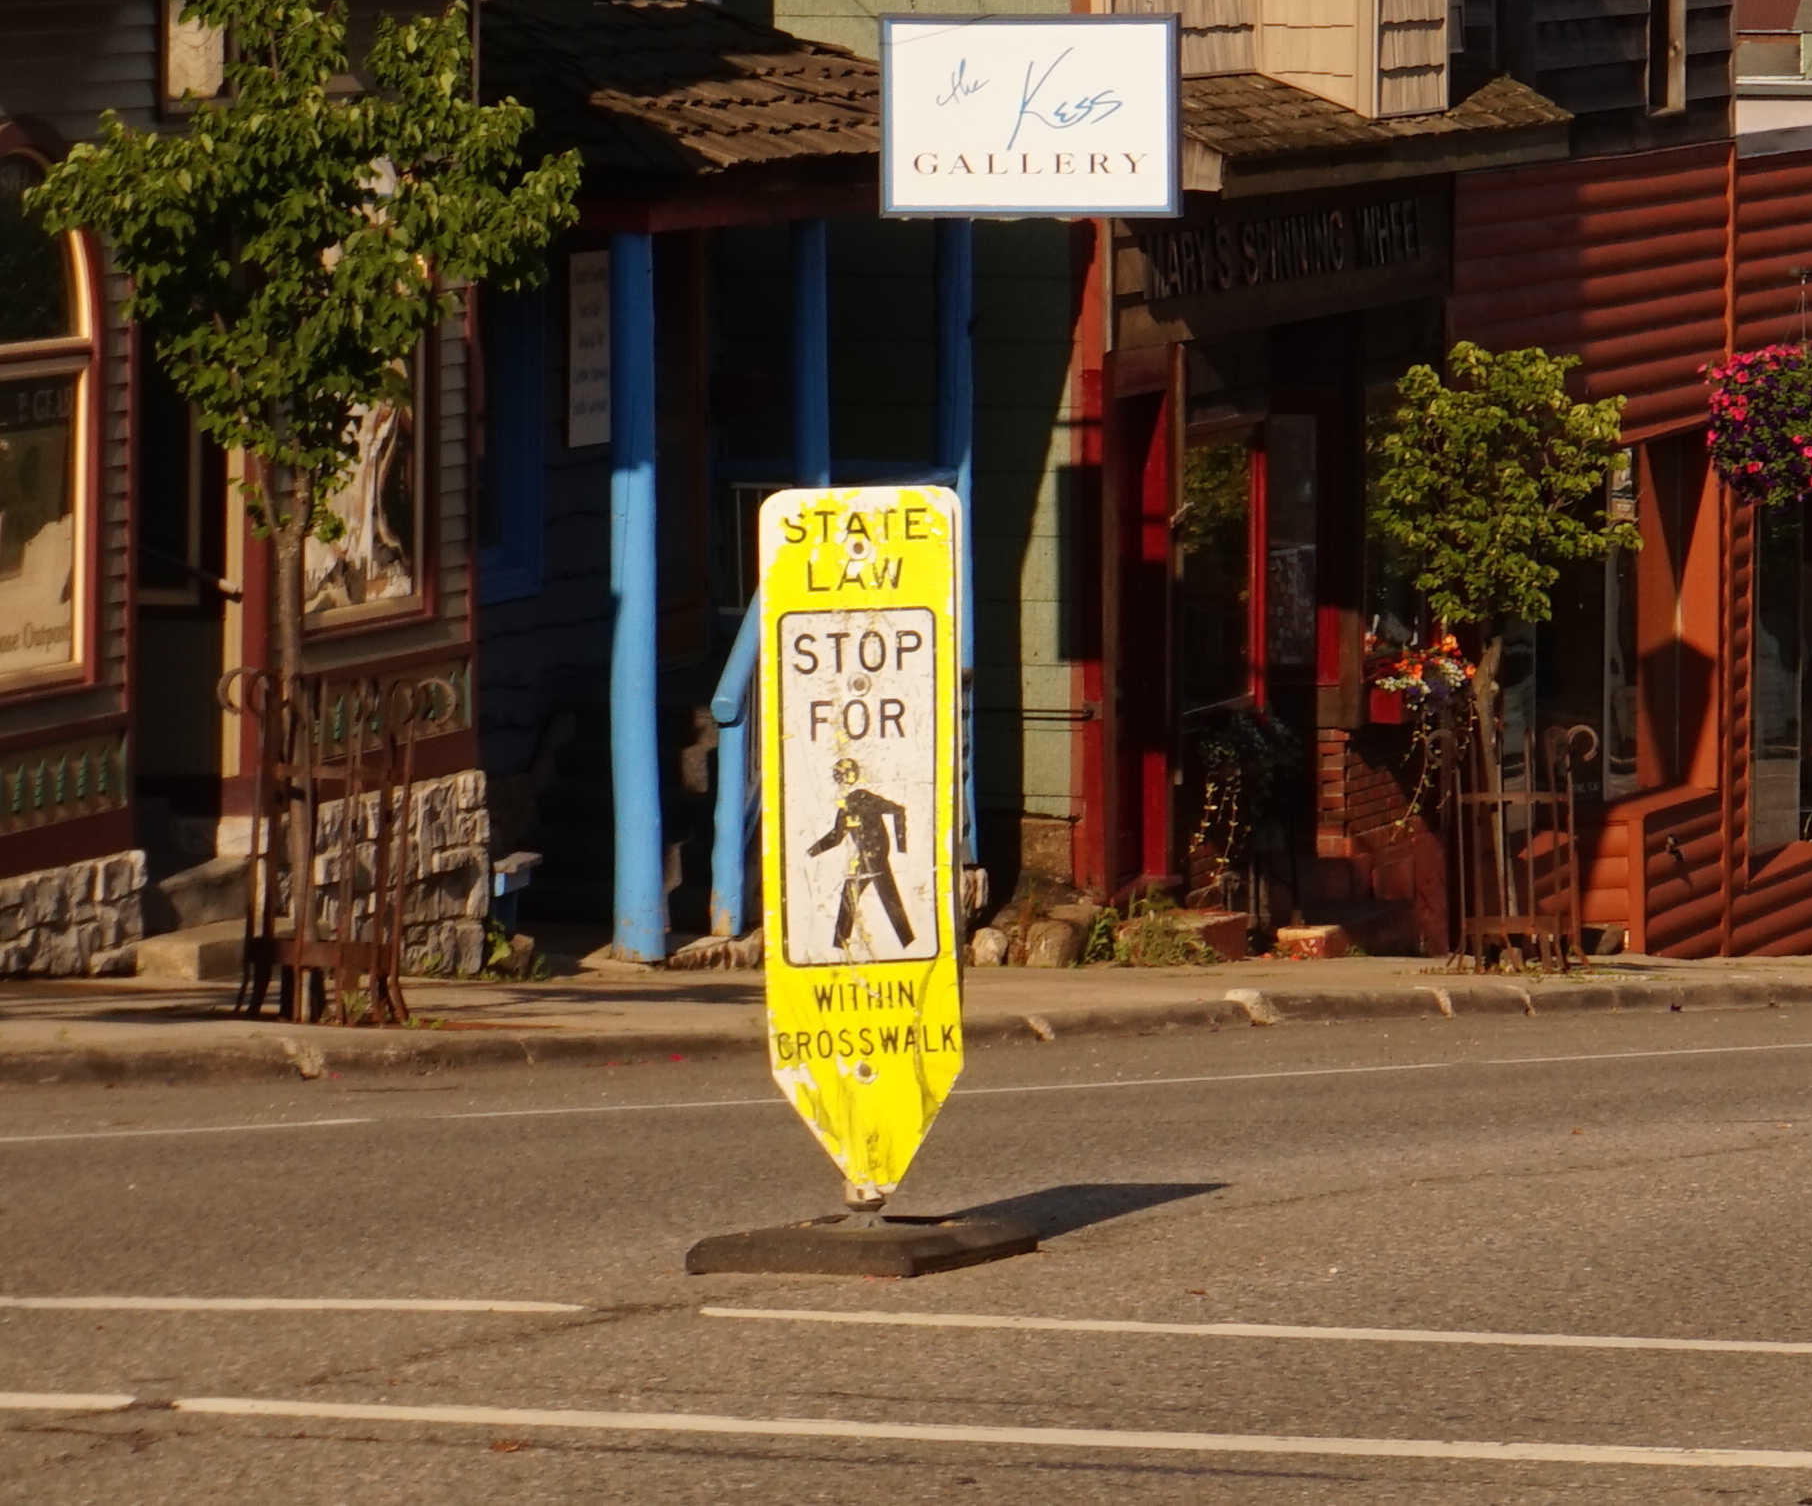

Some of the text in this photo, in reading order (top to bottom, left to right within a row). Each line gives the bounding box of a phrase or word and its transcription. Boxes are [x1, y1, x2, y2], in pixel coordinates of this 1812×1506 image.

[935, 58, 990, 107] the
[913, 152, 1149, 176] GALLERY
[1143, 218, 1231, 300] MARY'S
[1240, 209, 1345, 285] SPINNING
[783, 508, 929, 544] STATE
[806, 559, 903, 591] LAW
[793, 630, 924, 676] STOP
[810, 698, 907, 741] FOR
[813, 983, 916, 1013] WITHIN
[776, 1024, 958, 1061] CROSSWALK
